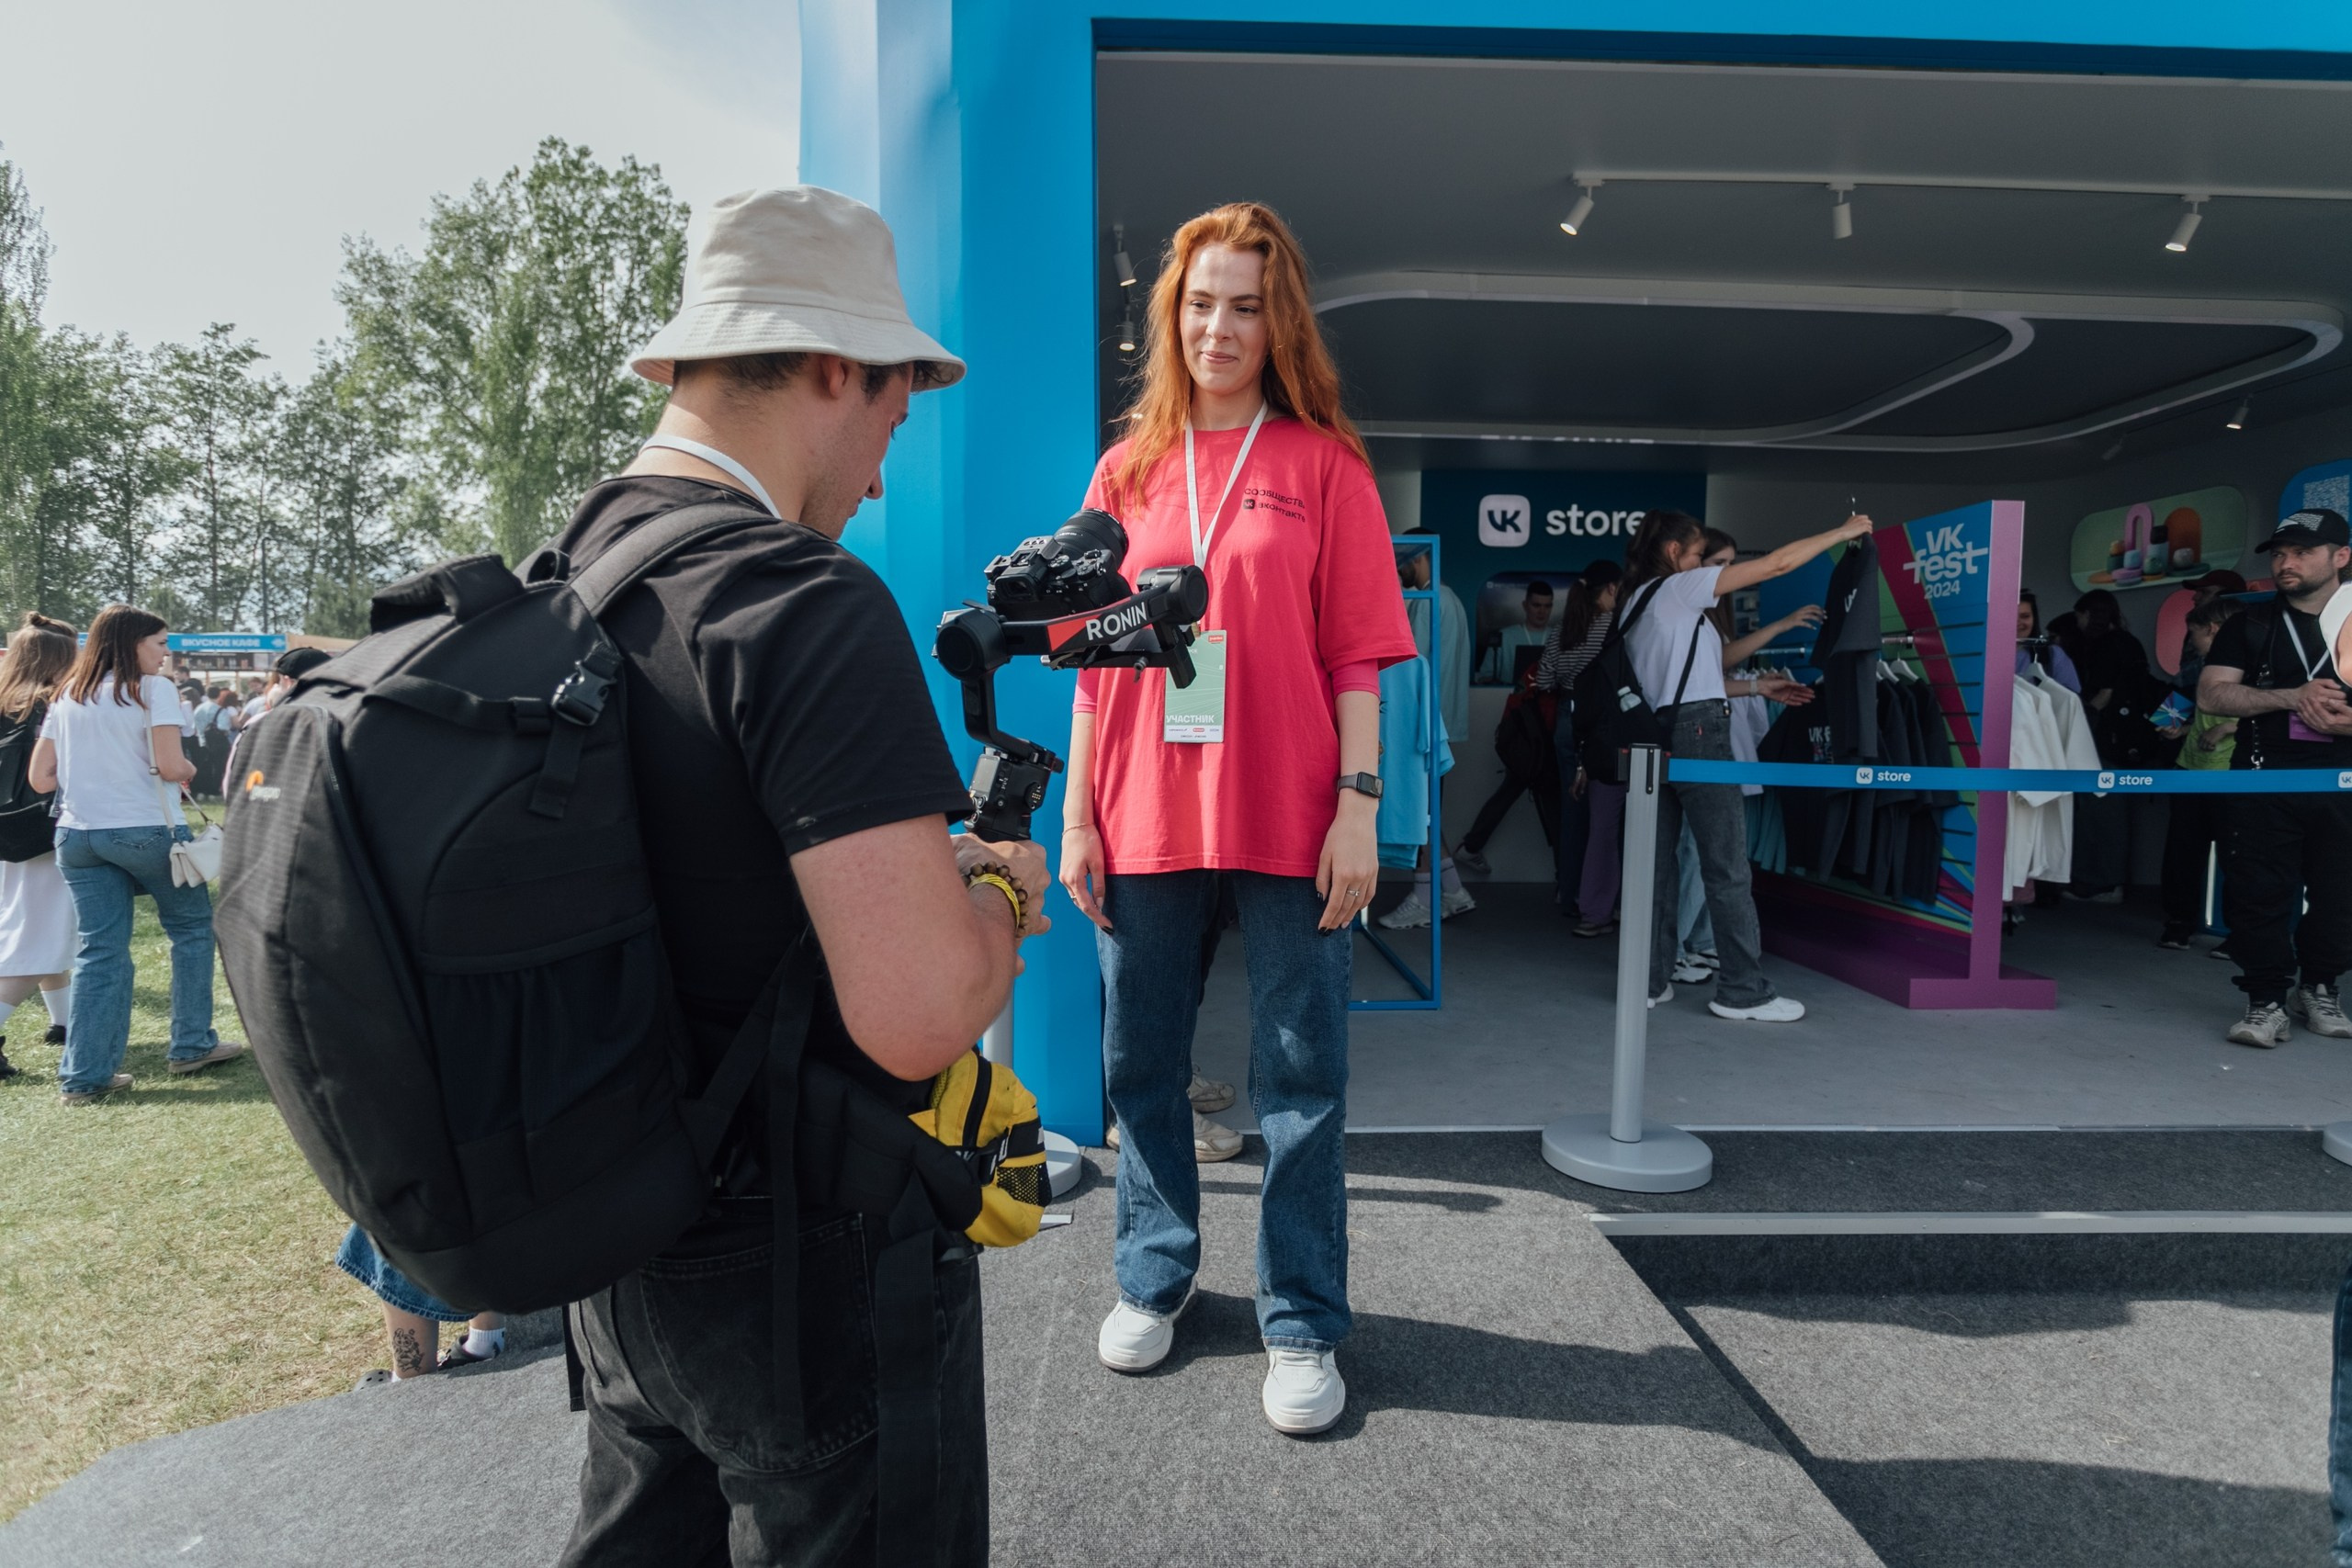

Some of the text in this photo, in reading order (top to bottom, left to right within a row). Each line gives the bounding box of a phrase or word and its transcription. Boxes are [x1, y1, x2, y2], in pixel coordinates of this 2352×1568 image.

[1487, 503, 1646, 536] VK store
[1926, 523, 1964, 555] VK
[1903, 541, 1988, 584] fest
[1924, 580, 1961, 600] 2024
[1085, 602, 1148, 641] RONIN
[1166, 715, 1215, 724] УЧАСТНИК
[1877, 770, 1911, 782] store
[2119, 774, 2154, 785] store
